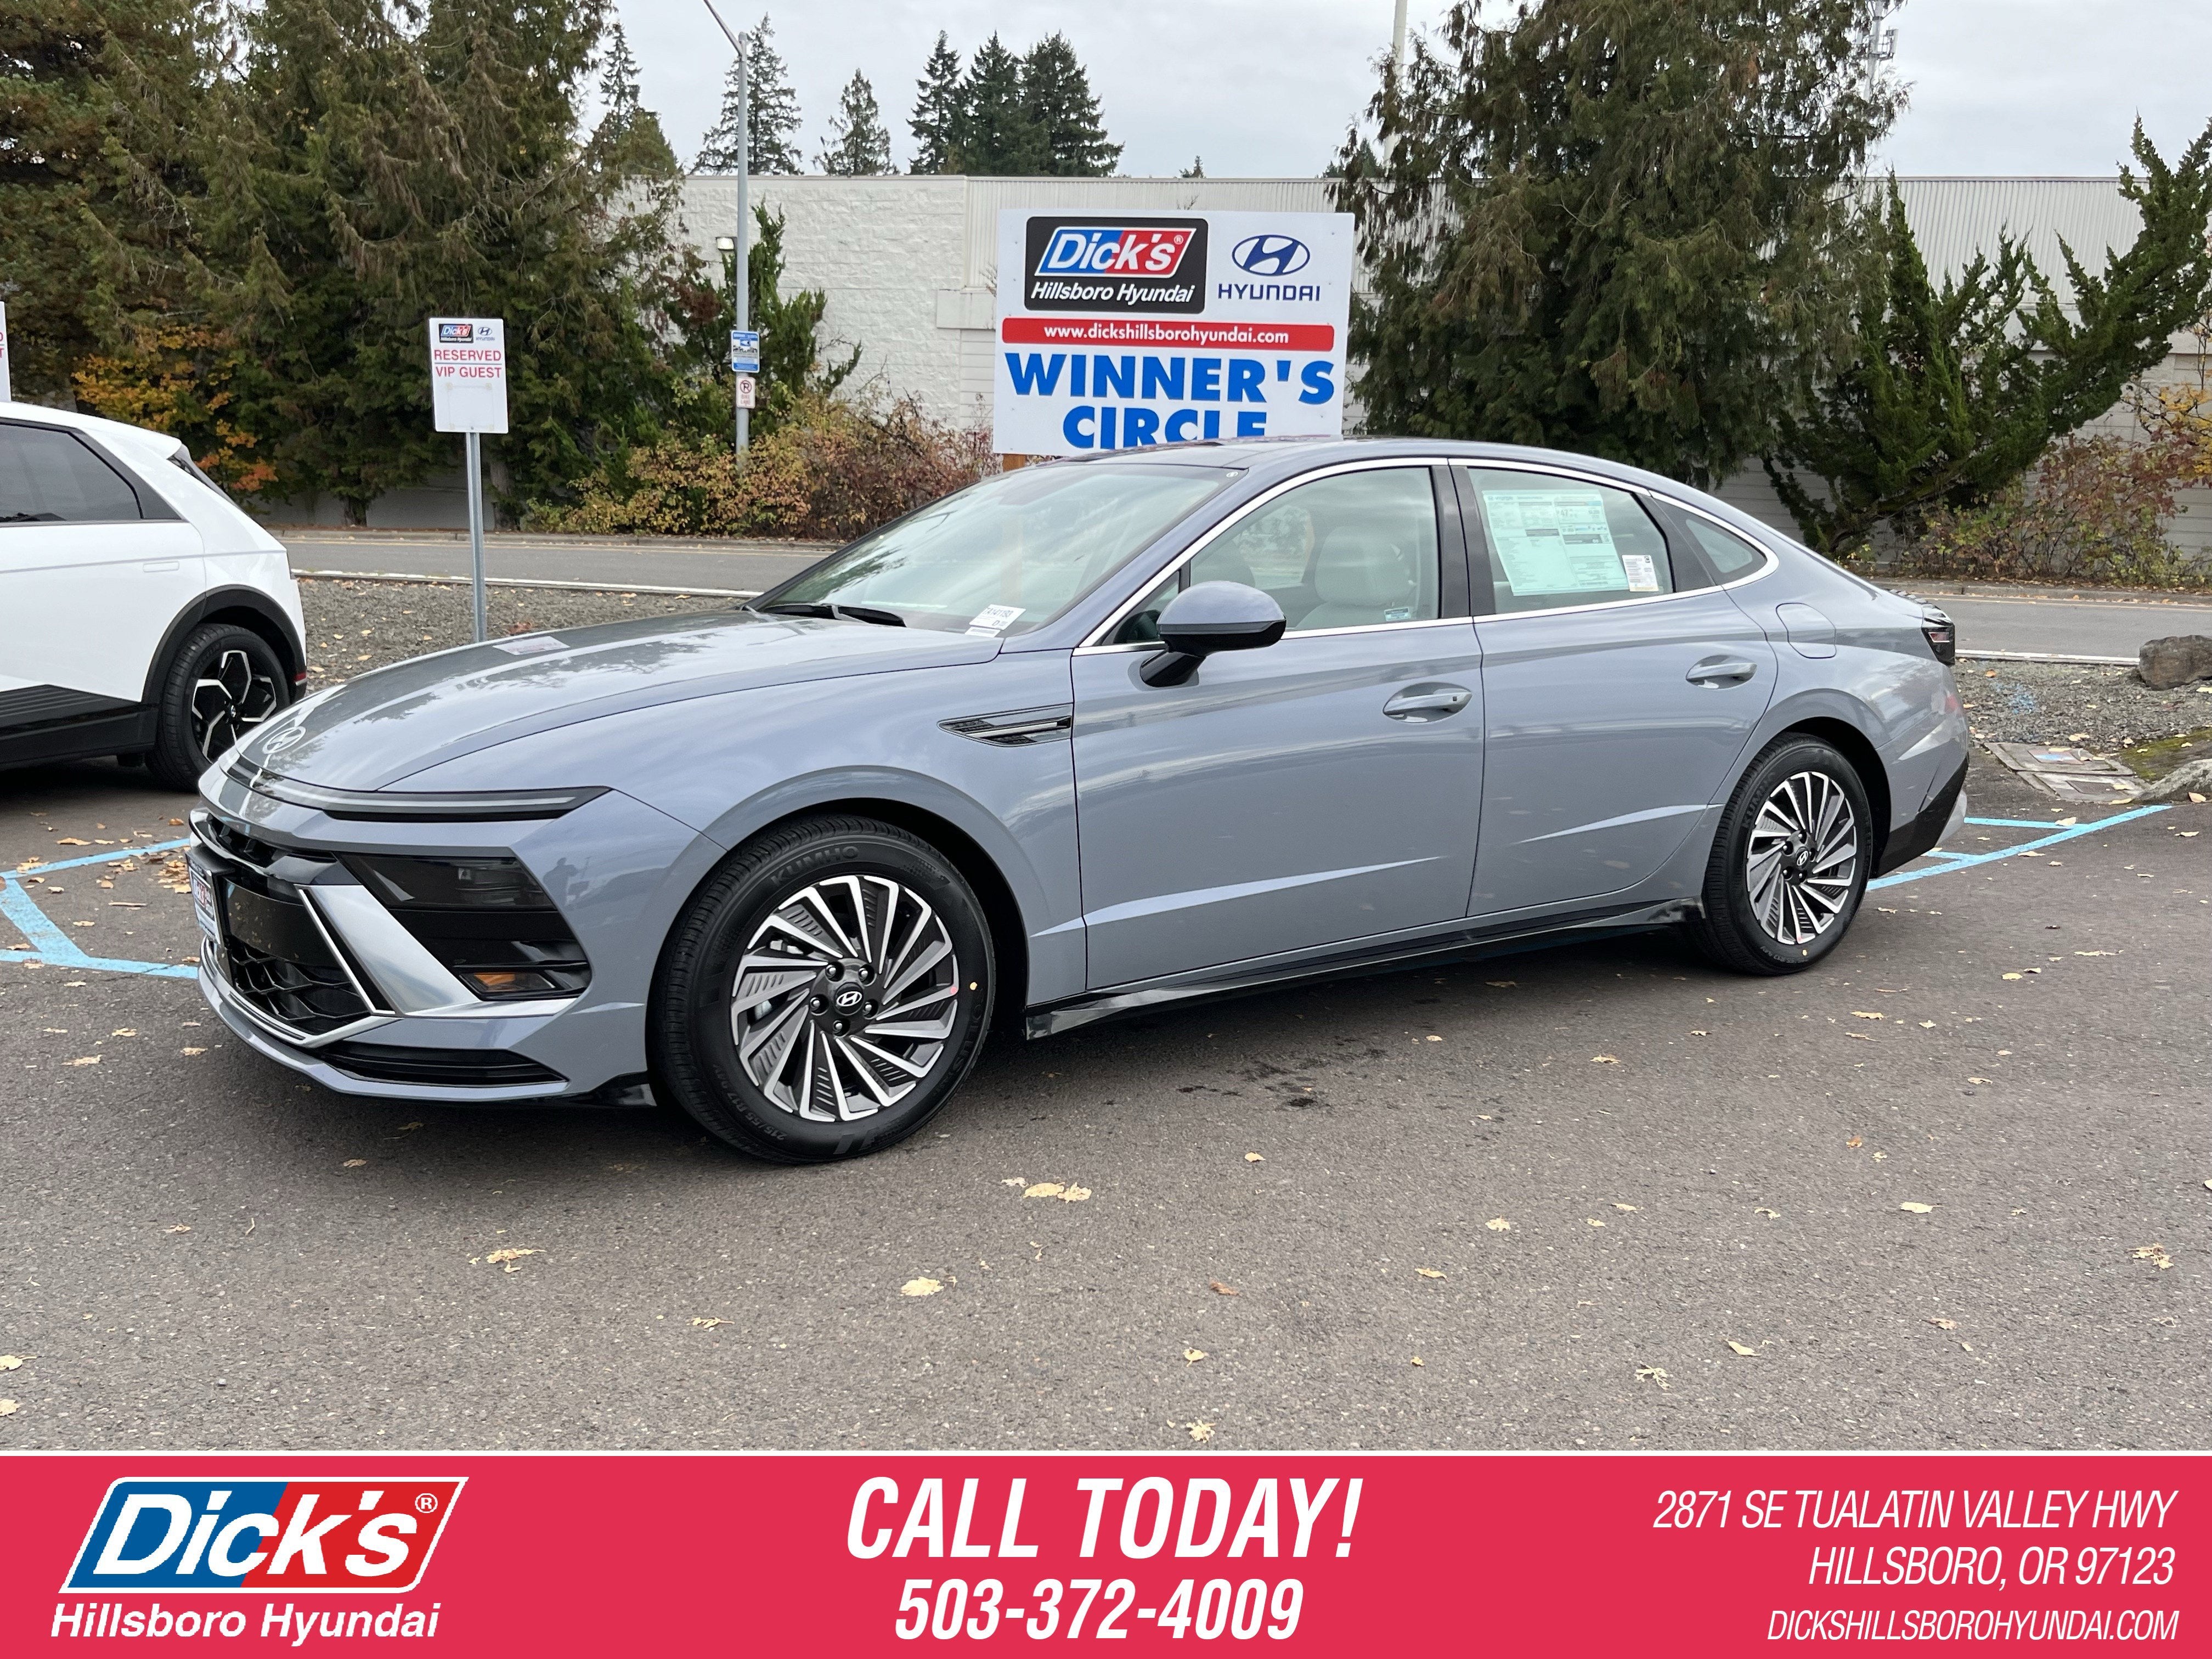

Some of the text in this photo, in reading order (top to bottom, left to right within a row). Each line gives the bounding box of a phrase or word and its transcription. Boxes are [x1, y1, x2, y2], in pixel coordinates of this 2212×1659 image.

[1047, 232, 1176, 271] Dick's
[1031, 281, 1195, 306] Hillsboro Hyundai
[1217, 284, 1320, 301] HYUNDAI
[1043, 322, 1289, 348] www.dickshillsborohyundai.com
[434, 349, 501, 361] RESERVED
[436, 366, 502, 379] VIP GUEST
[1005, 352, 1334, 405] WINNER'S
[771, 845, 859, 886] KUMHO
[745, 1111, 788, 1141] 215/55
